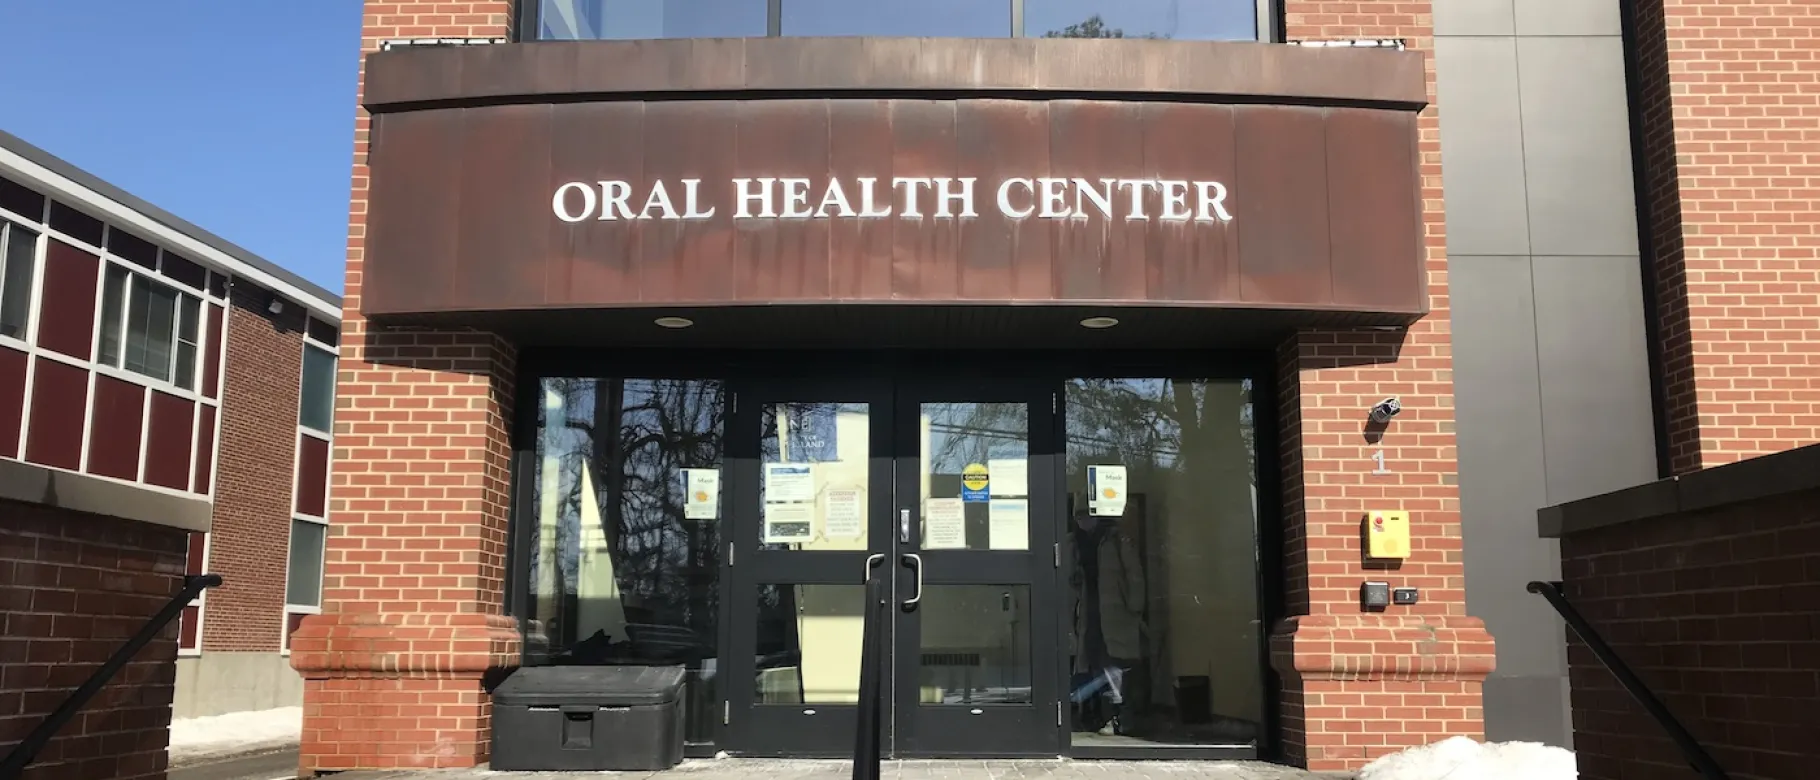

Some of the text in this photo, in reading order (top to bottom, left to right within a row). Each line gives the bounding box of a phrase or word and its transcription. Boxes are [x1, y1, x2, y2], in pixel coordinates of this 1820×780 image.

[552, 177, 1233, 222] ORAL HEALTH CENTER
[1371, 449, 1391, 474] 1
